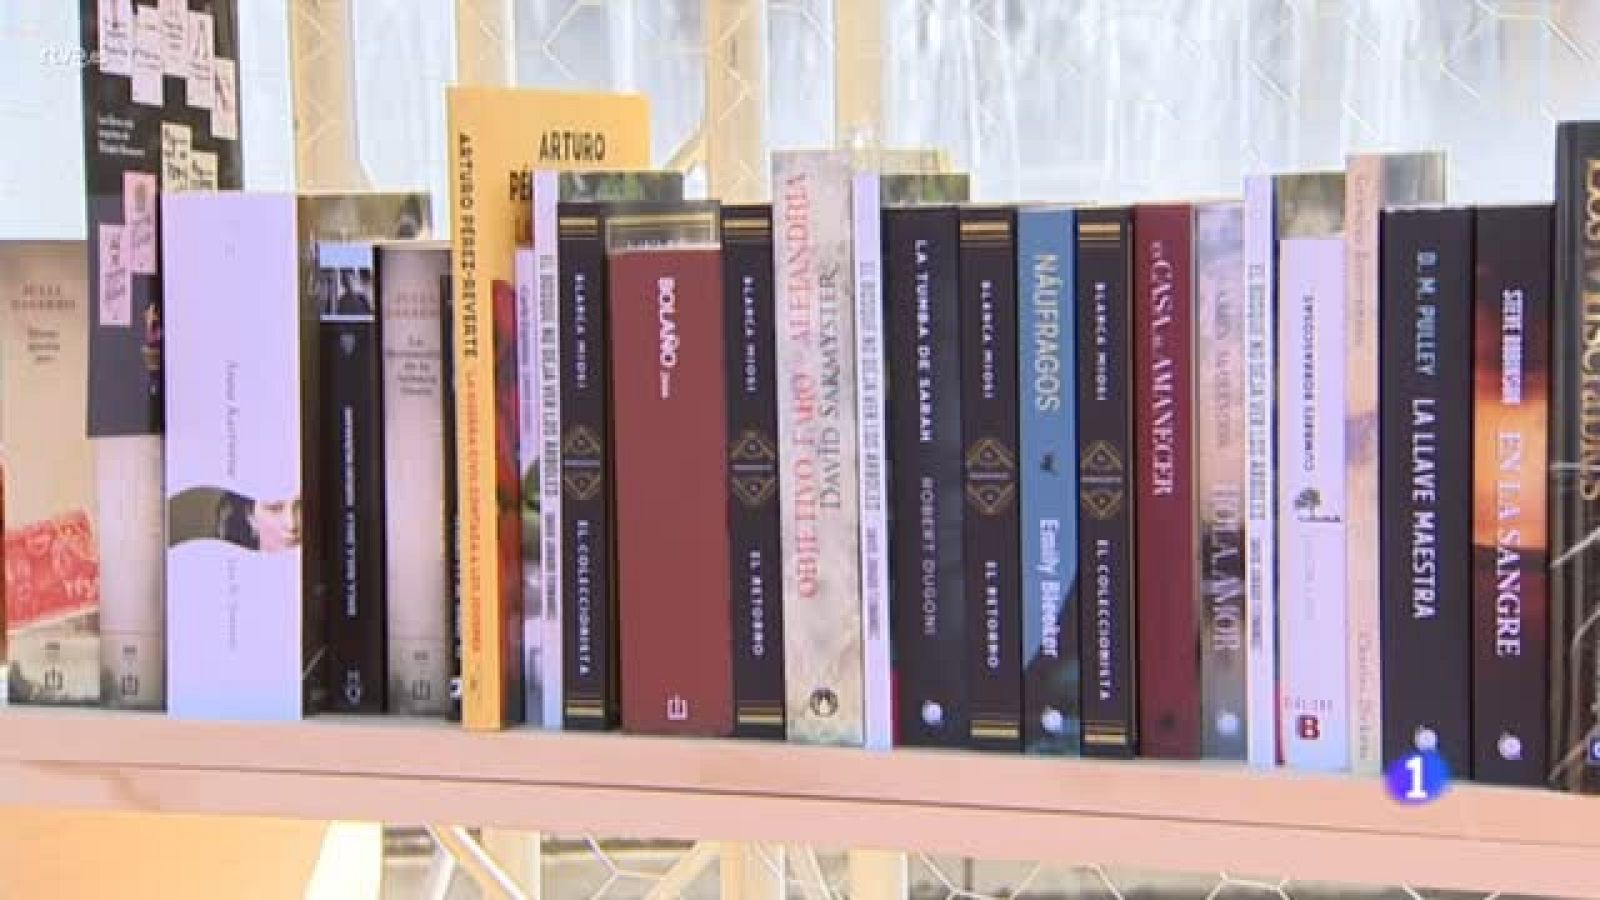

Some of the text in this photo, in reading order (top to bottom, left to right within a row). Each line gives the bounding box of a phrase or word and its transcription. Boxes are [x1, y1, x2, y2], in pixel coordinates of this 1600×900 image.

[540, 131, 605, 160] ARTURO
[460, 131, 479, 360] ARTURO PÉREZ-REVERTE
[574, 273, 586, 335] BLANCA
[742, 275, 755, 337] BLANCA
[981, 279, 994, 345] BLANCA
[1095, 281, 1106, 346] BLANCA
[1151, 259, 1174, 328] CASA
[657, 276, 680, 367] BOLAÑO
[915, 239, 934, 441] LA TUMBA DE SARAH
[1033, 254, 1063, 412] NÁUFRAGOS
[1302, 295, 1316, 471] CUMBRES BORRASCOSAS
[818, 427, 841, 509] DAVID
[1151, 358, 1175, 496] AMANECER
[1412, 251, 1437, 618] D. M. PULLEY LA LLAVE MAESTRA
[577, 519, 591, 676] EL COLECCIONISTA
[750, 551, 764, 656] EL RETORNO
[920, 476, 937, 635] ROBERT DUGONI
[1036, 519, 1062, 658] Emily Bleeker
[1497, 431, 1522, 656] EN LA SANGRE
[985, 560, 1000, 669] EL RETORNO
[1097, 539, 1111, 701] EL COLECCIONISTA
